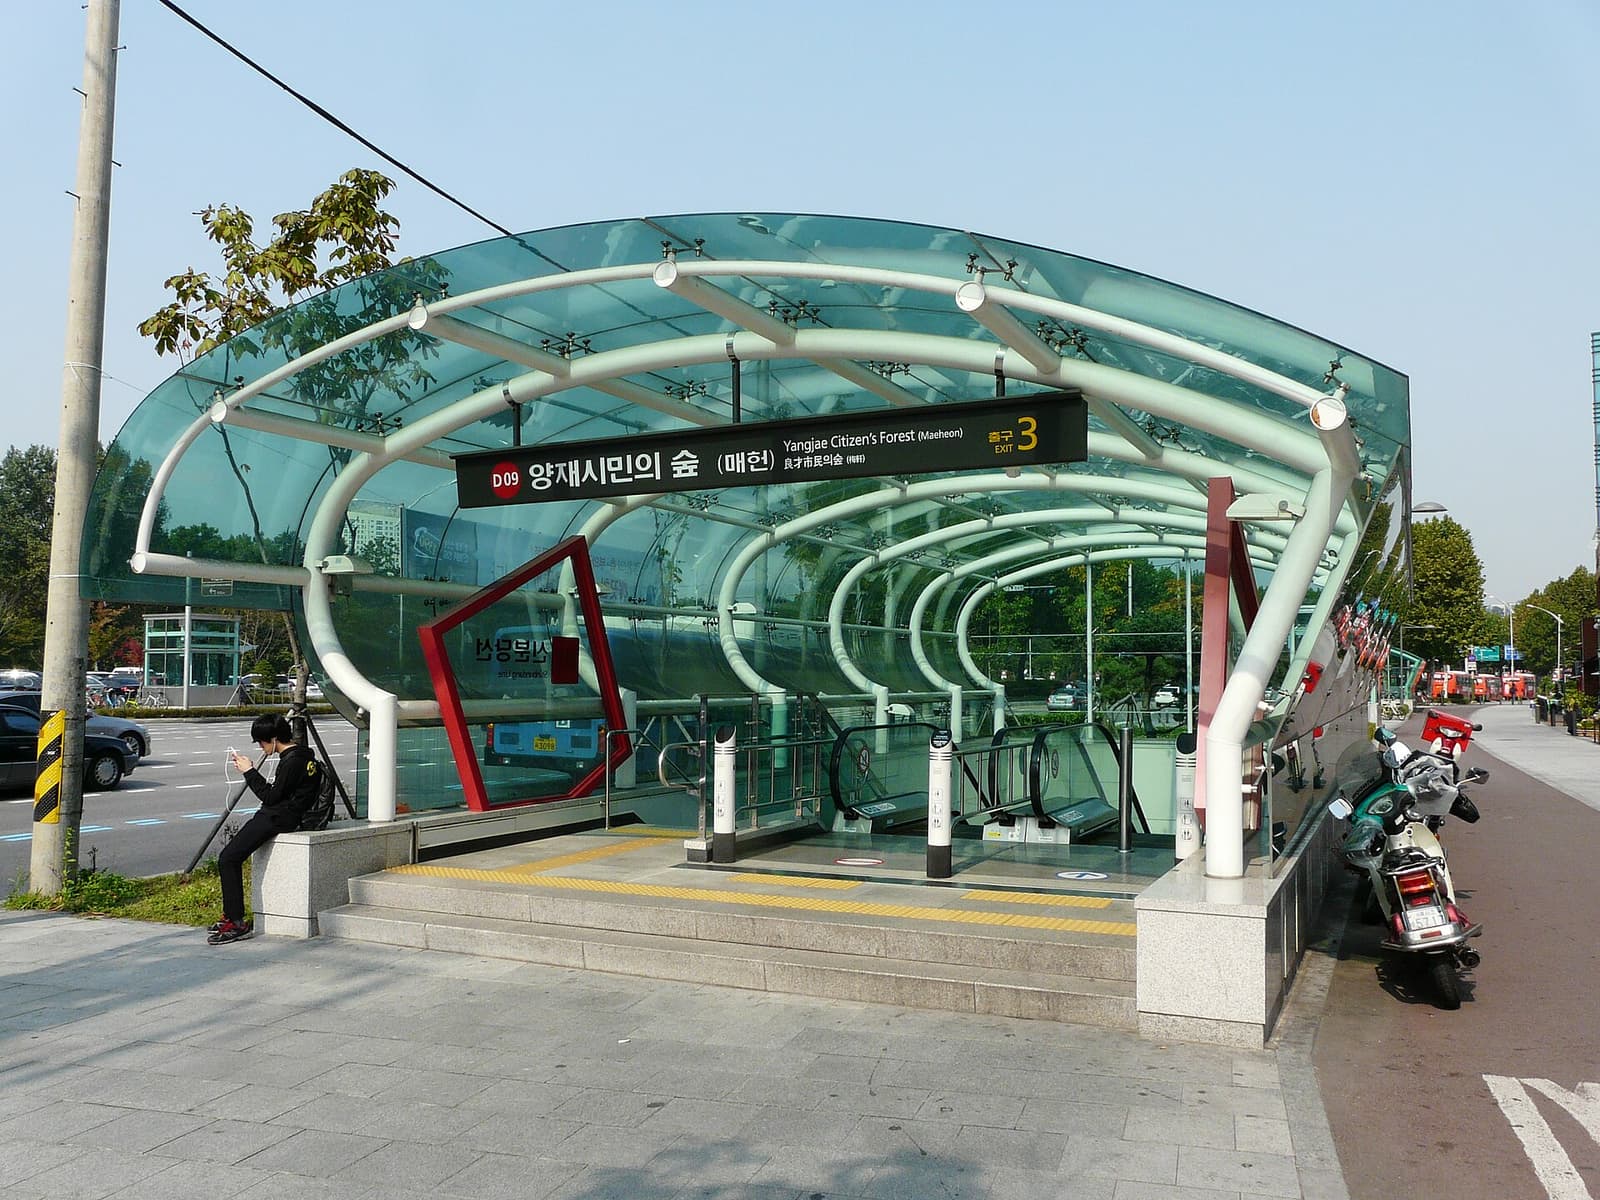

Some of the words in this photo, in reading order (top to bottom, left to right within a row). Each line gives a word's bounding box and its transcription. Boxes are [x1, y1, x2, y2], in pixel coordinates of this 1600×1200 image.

[784, 439, 828, 454] Yangjae
[831, 432, 878, 448] Citizen's
[880, 429, 916, 444] Forest
[918, 427, 964, 441] (Maeheon)
[1017, 416, 1038, 450] 3
[994, 443, 1014, 454] EXIT
[528, 451, 661, 491] 양재시민의
[670, 449, 700, 479] 숲
[717, 449, 775, 475] (매헌)
